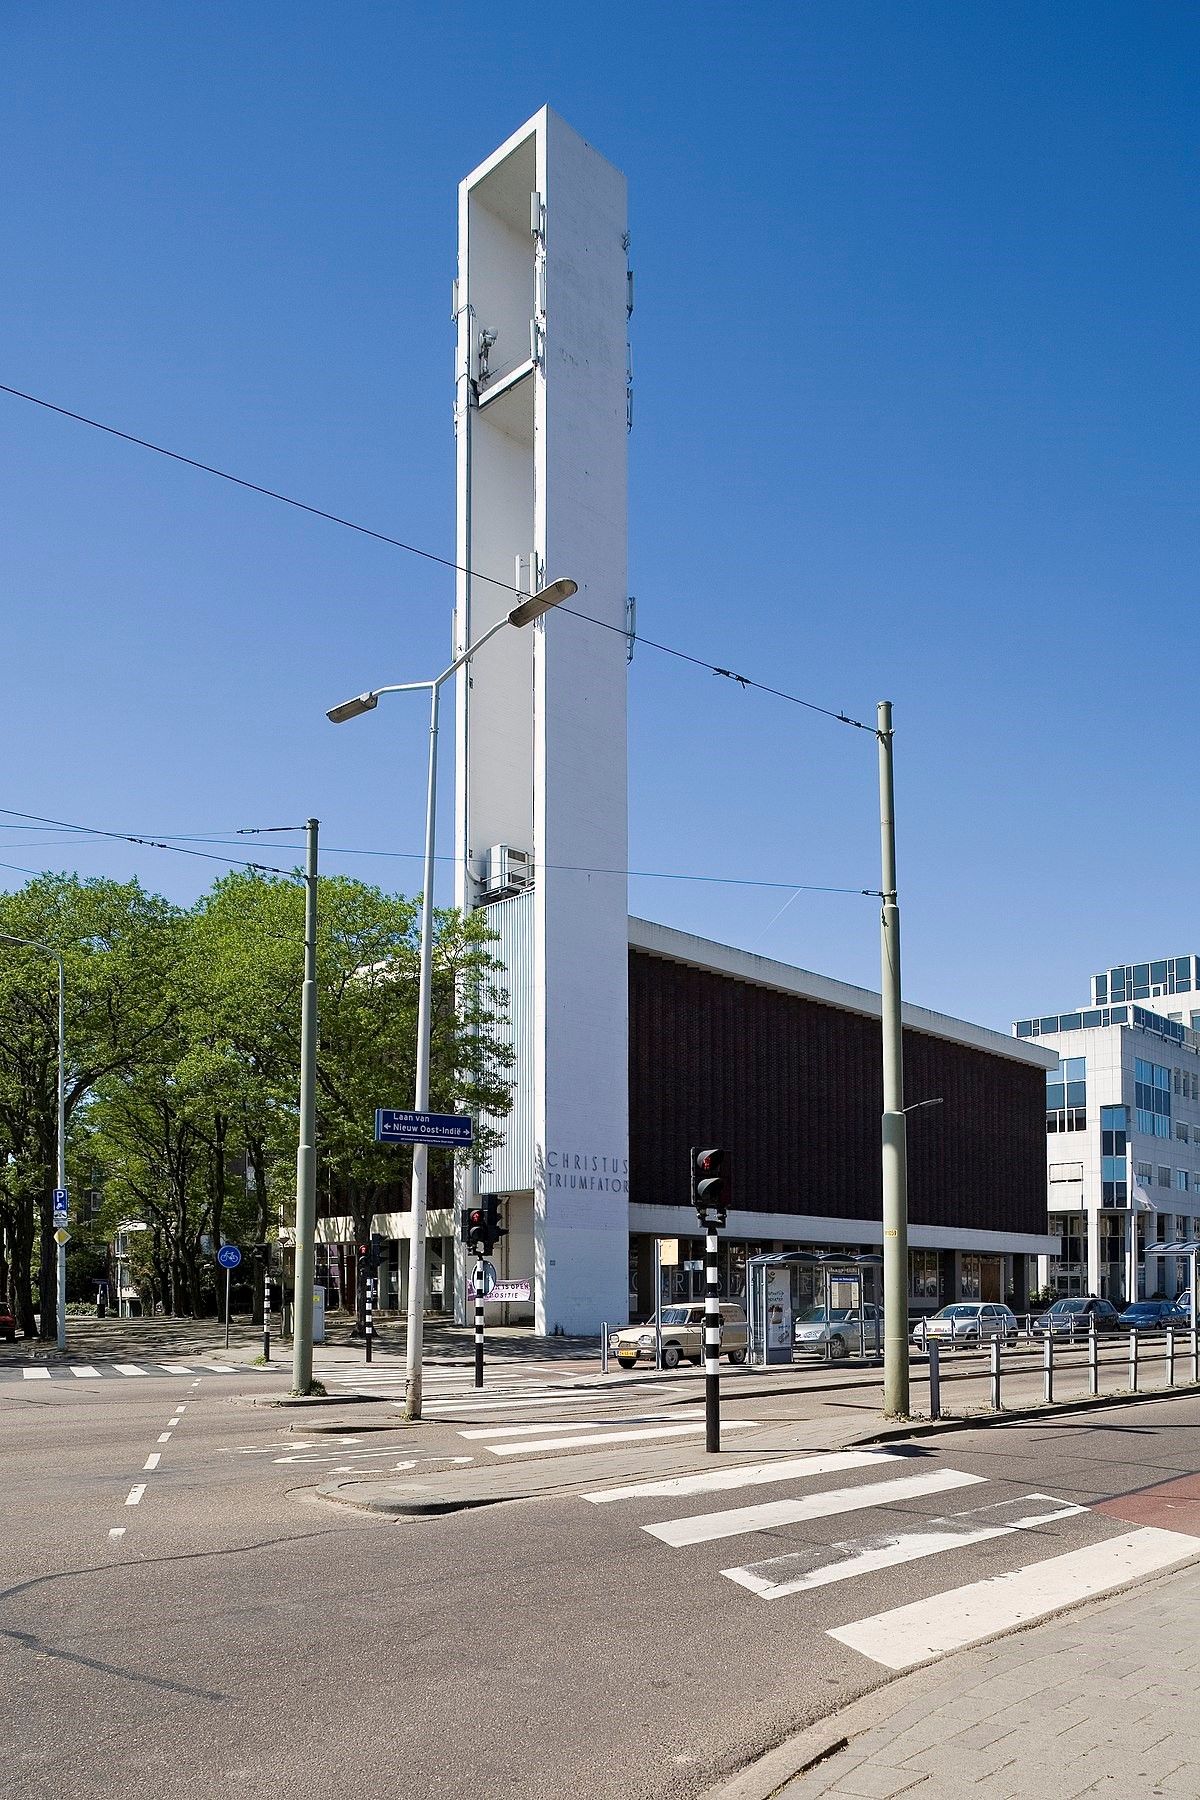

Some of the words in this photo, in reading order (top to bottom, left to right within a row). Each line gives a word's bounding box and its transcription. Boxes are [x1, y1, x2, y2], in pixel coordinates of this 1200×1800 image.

[393, 1112, 413, 1121] Laan
[393, 1123, 418, 1132] Nieuw
[420, 1125, 461, 1135] Oost-Indië
[547, 1151, 628, 1174] CHRISTUS
[548, 1173, 629, 1193] TRIUMFATOR
